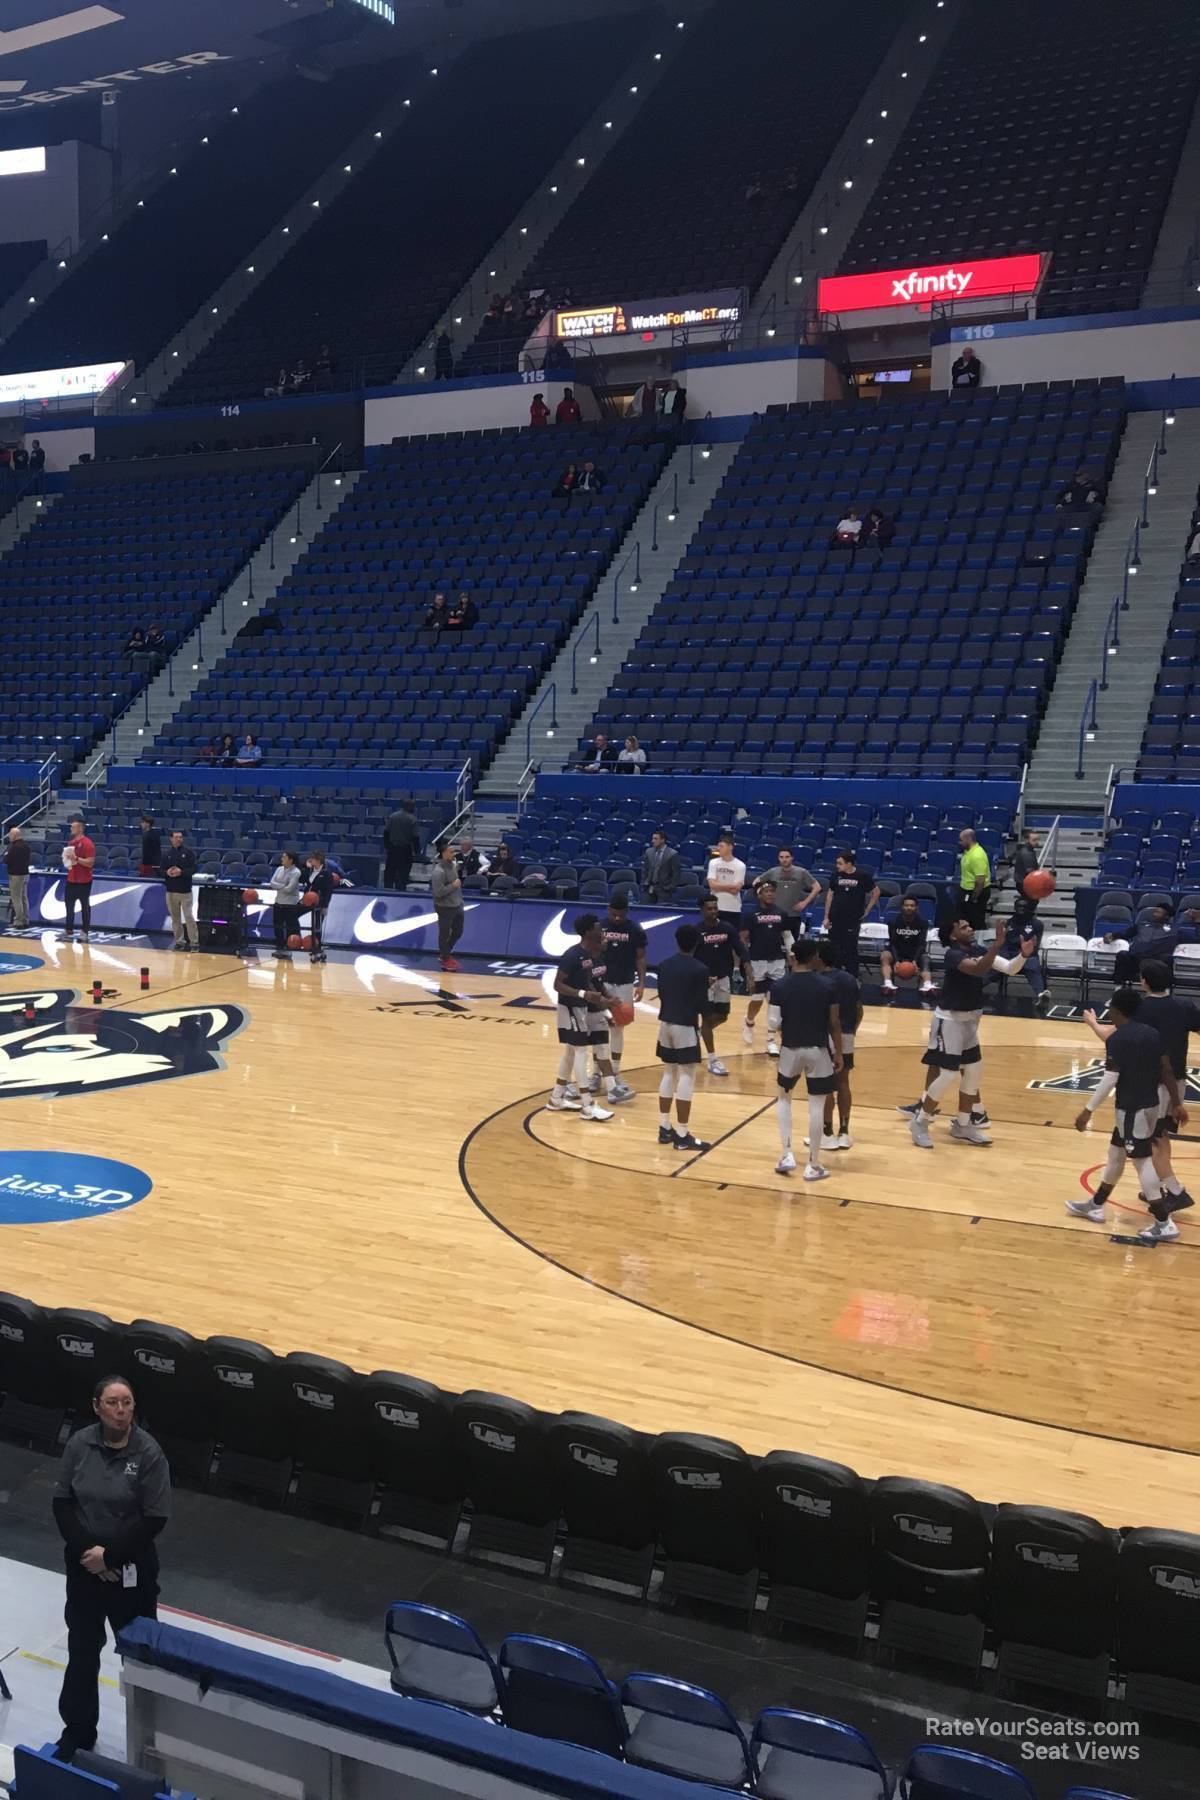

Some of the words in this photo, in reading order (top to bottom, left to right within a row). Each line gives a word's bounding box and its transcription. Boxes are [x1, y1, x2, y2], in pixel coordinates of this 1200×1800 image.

[891, 269, 973, 300] xfinity
[562, 313, 614, 330] WATCH
[631, 307, 739, 329] WatchForMeCT.org
[603, 325, 613, 334] CT
[963, 325, 995, 340] 116
[521, 370, 545, 382] 115
[220, 405, 240, 417] 114
[757, 914, 782, 923] UCONN
[703, 934, 728, 943] UCONN
[410, 1010, 535, 1026] CENTER
[52, 1196, 100, 1209] EXAM
[60, 1338, 95, 1354] LAZ
[138, 1352, 176, 1371] LAZ
[217, 1368, 255, 1386] LAZ
[296, 1386, 335, 1407] LAZ
[379, 1404, 420, 1425] LAZ
[473, 1425, 516, 1449] LAZ
[573, 1447, 619, 1474] LAZ
[673, 1471, 722, 1485] LAZ
[781, 1488, 832, 1514] LAZ
[899, 1517, 952, 1541] LAZ
[1023, 1547, 1079, 1568] LAZ
